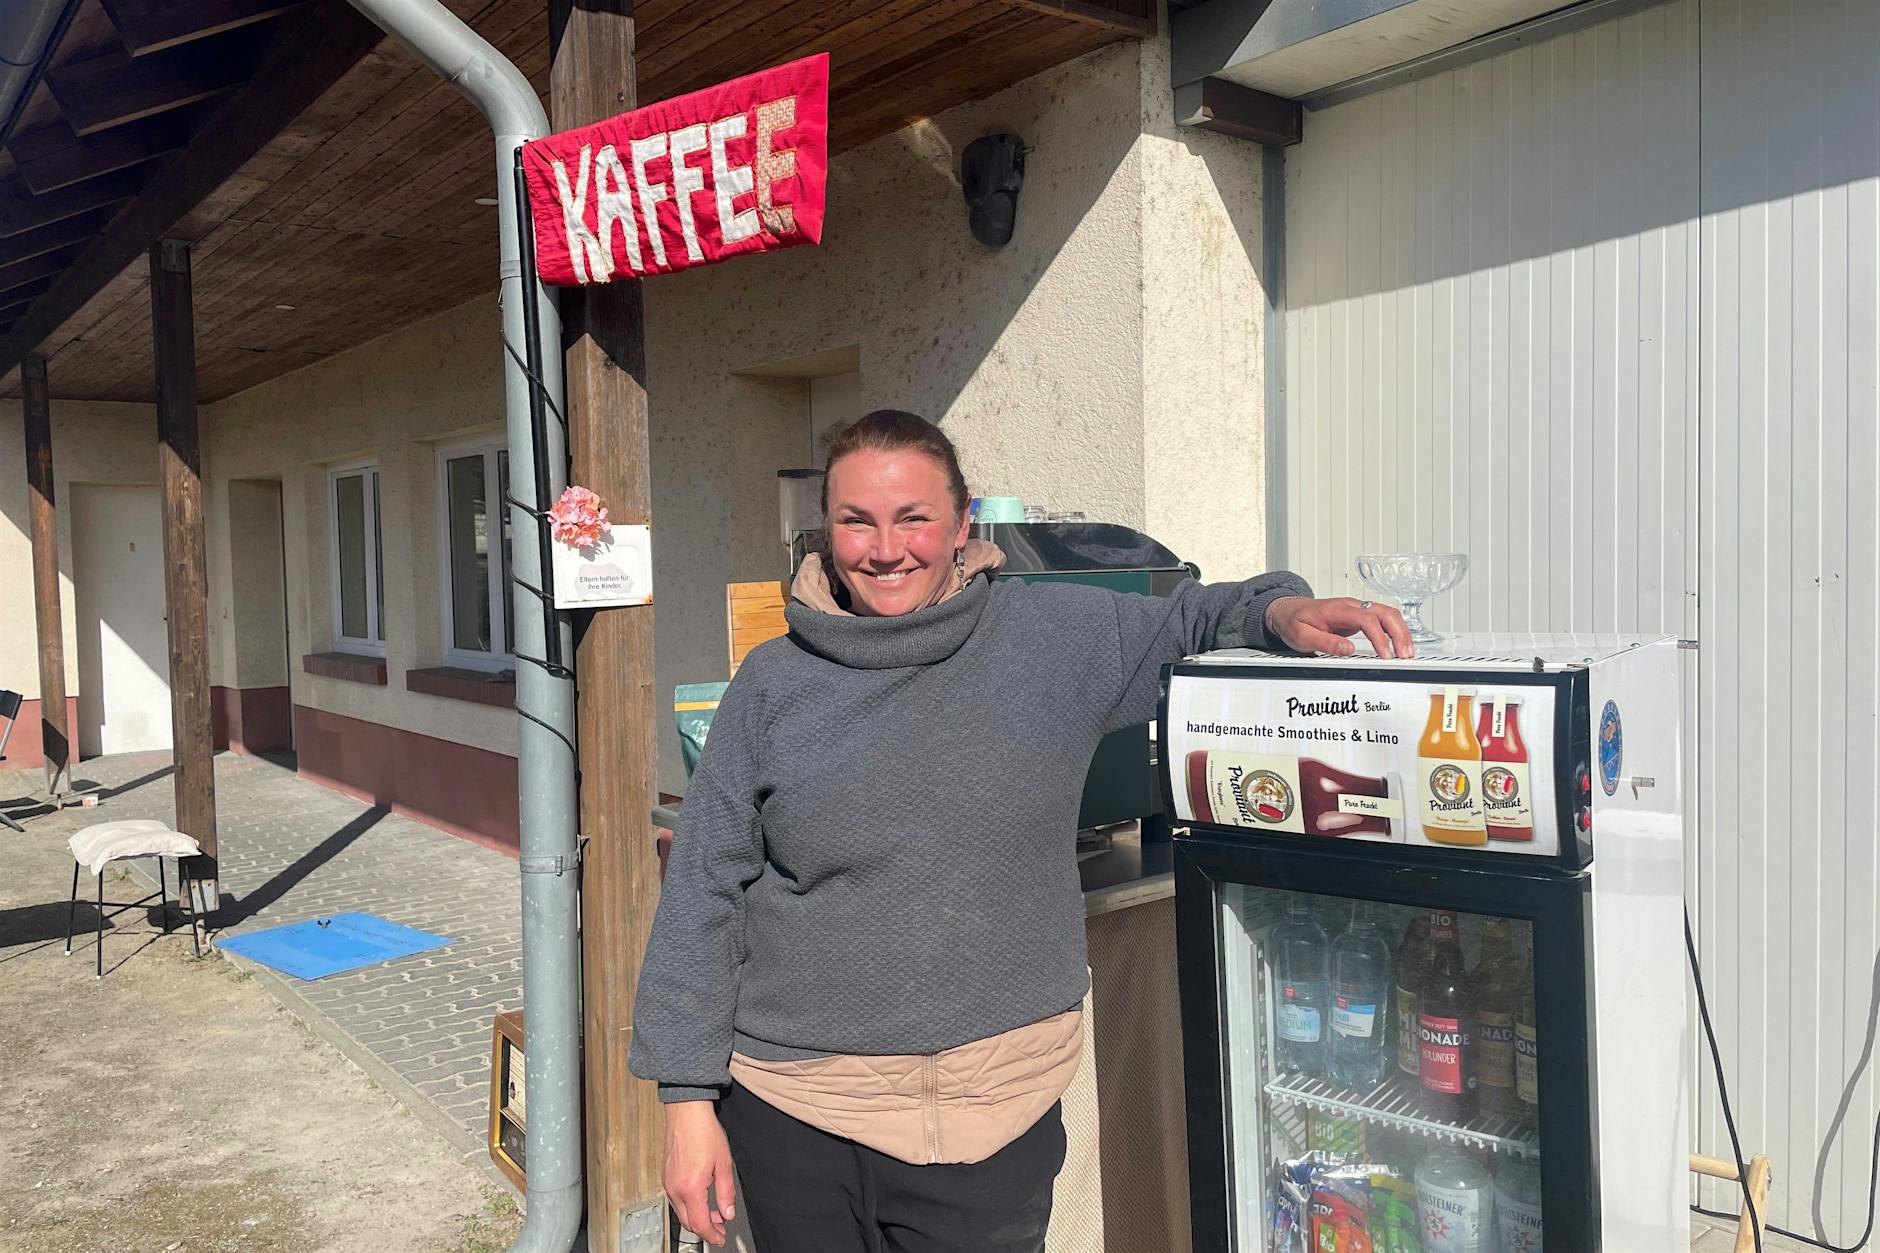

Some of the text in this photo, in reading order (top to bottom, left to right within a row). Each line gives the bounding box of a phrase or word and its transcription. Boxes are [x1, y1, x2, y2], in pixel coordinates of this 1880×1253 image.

[551, 94, 798, 285] KAFFEE
[1286, 694, 1391, 718] Proviant Berlin
[1186, 721, 1399, 745] handgemachte Smoothies & Limo
[1228, 765, 1256, 824] Proviant
[1429, 798, 1474, 812] Proviant
[1430, 913, 1451, 926] BIO
[1280, 1016, 1312, 1031] EDIUM
